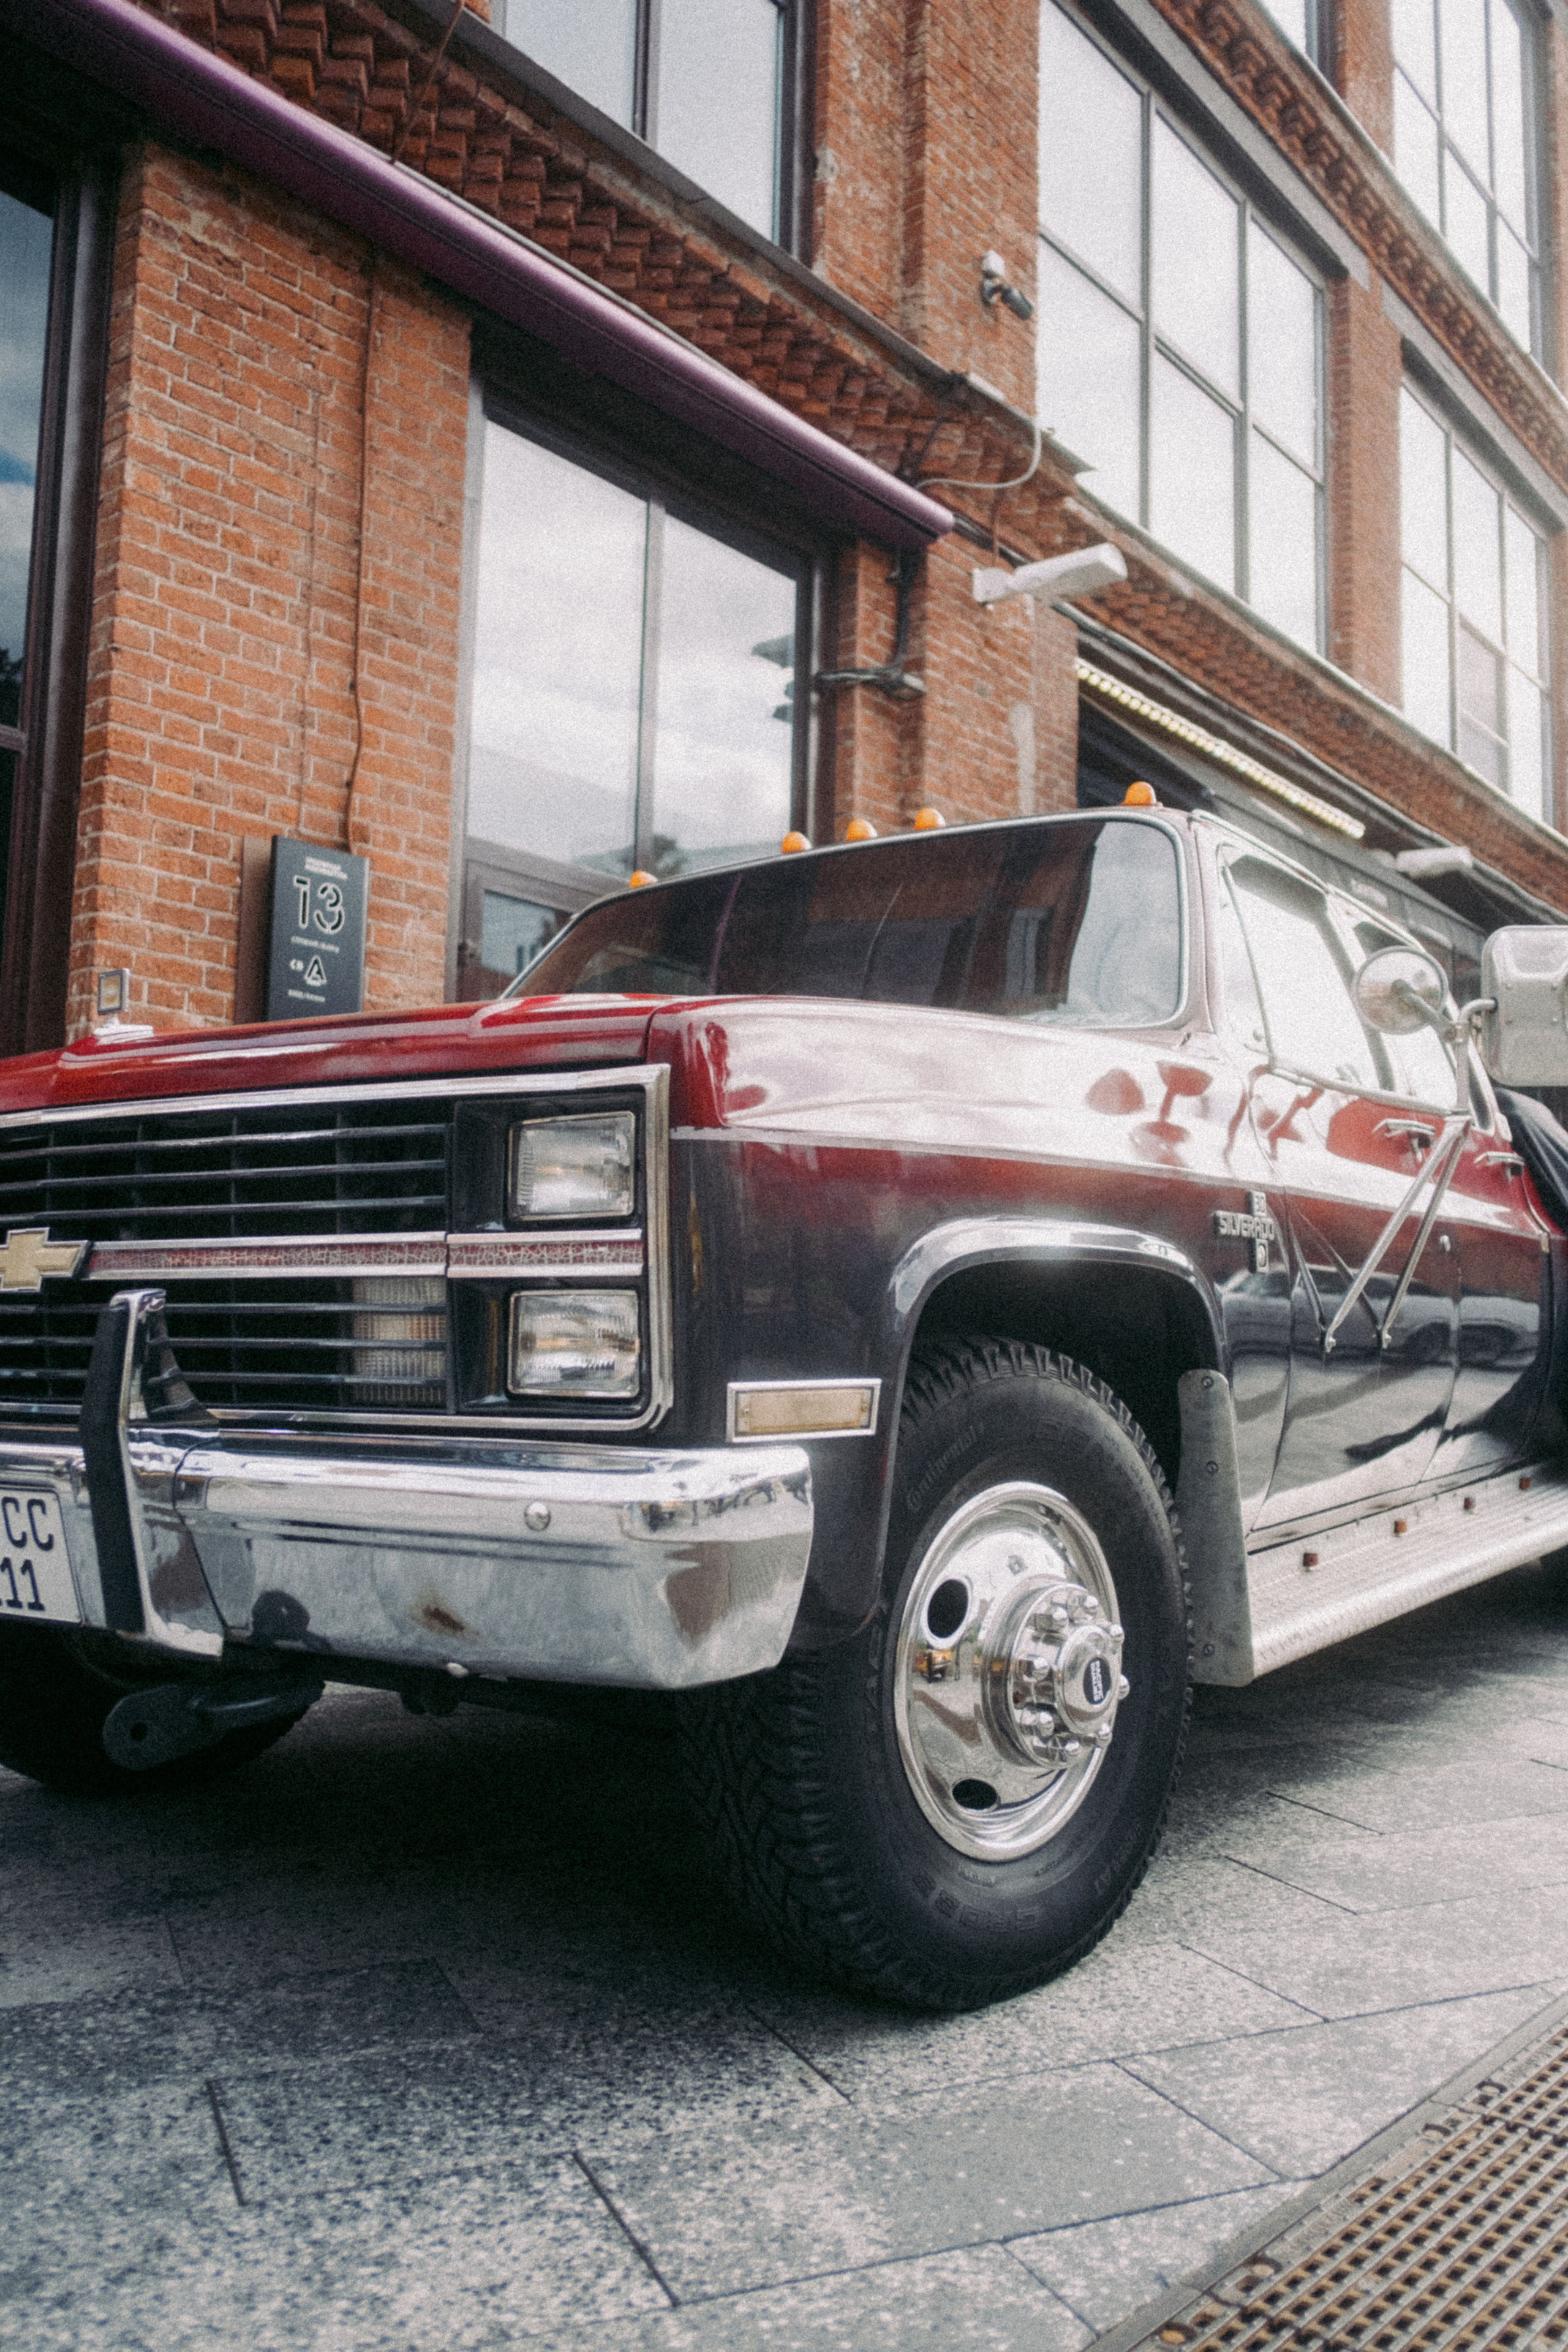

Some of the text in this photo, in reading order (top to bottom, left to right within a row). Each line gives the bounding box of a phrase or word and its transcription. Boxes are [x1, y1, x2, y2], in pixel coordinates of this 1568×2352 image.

[293, 875, 345, 934] 13
[1, 1496, 54, 1551] CC
[0, 1556, 45, 1611] 11
